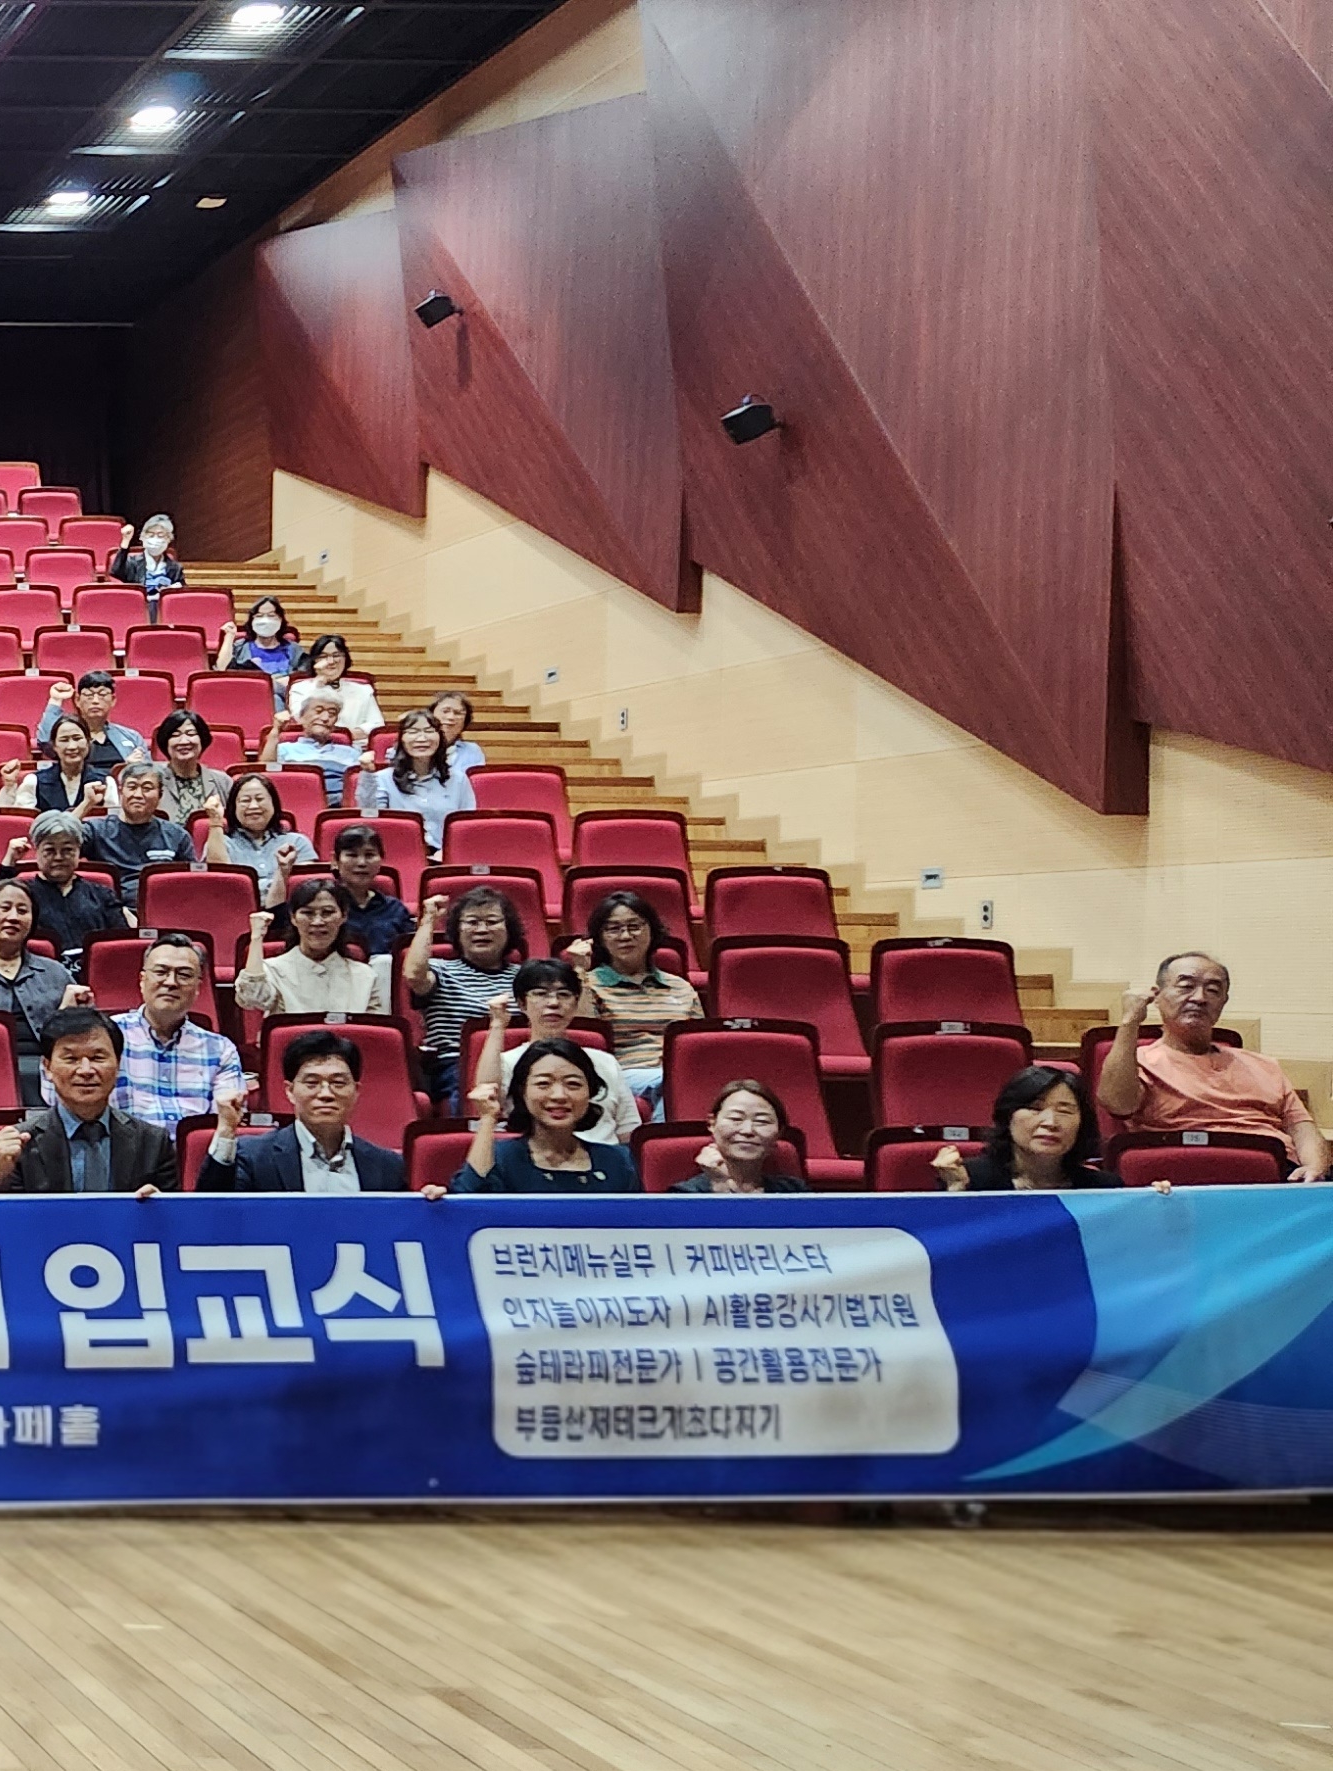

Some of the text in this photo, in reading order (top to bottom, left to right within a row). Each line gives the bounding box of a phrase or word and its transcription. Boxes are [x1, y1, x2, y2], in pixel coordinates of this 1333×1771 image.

[492, 1243, 656, 1279] 브런치메뉴실무
[684, 1243, 833, 1277] 커피바리스타
[44, 1241, 445, 1369] 입교식
[503, 1296, 672, 1329] 인지놀이지도자
[514, 1348, 683, 1386] 숲테라피전문가
[713, 1347, 883, 1385] 공간활용전문가
